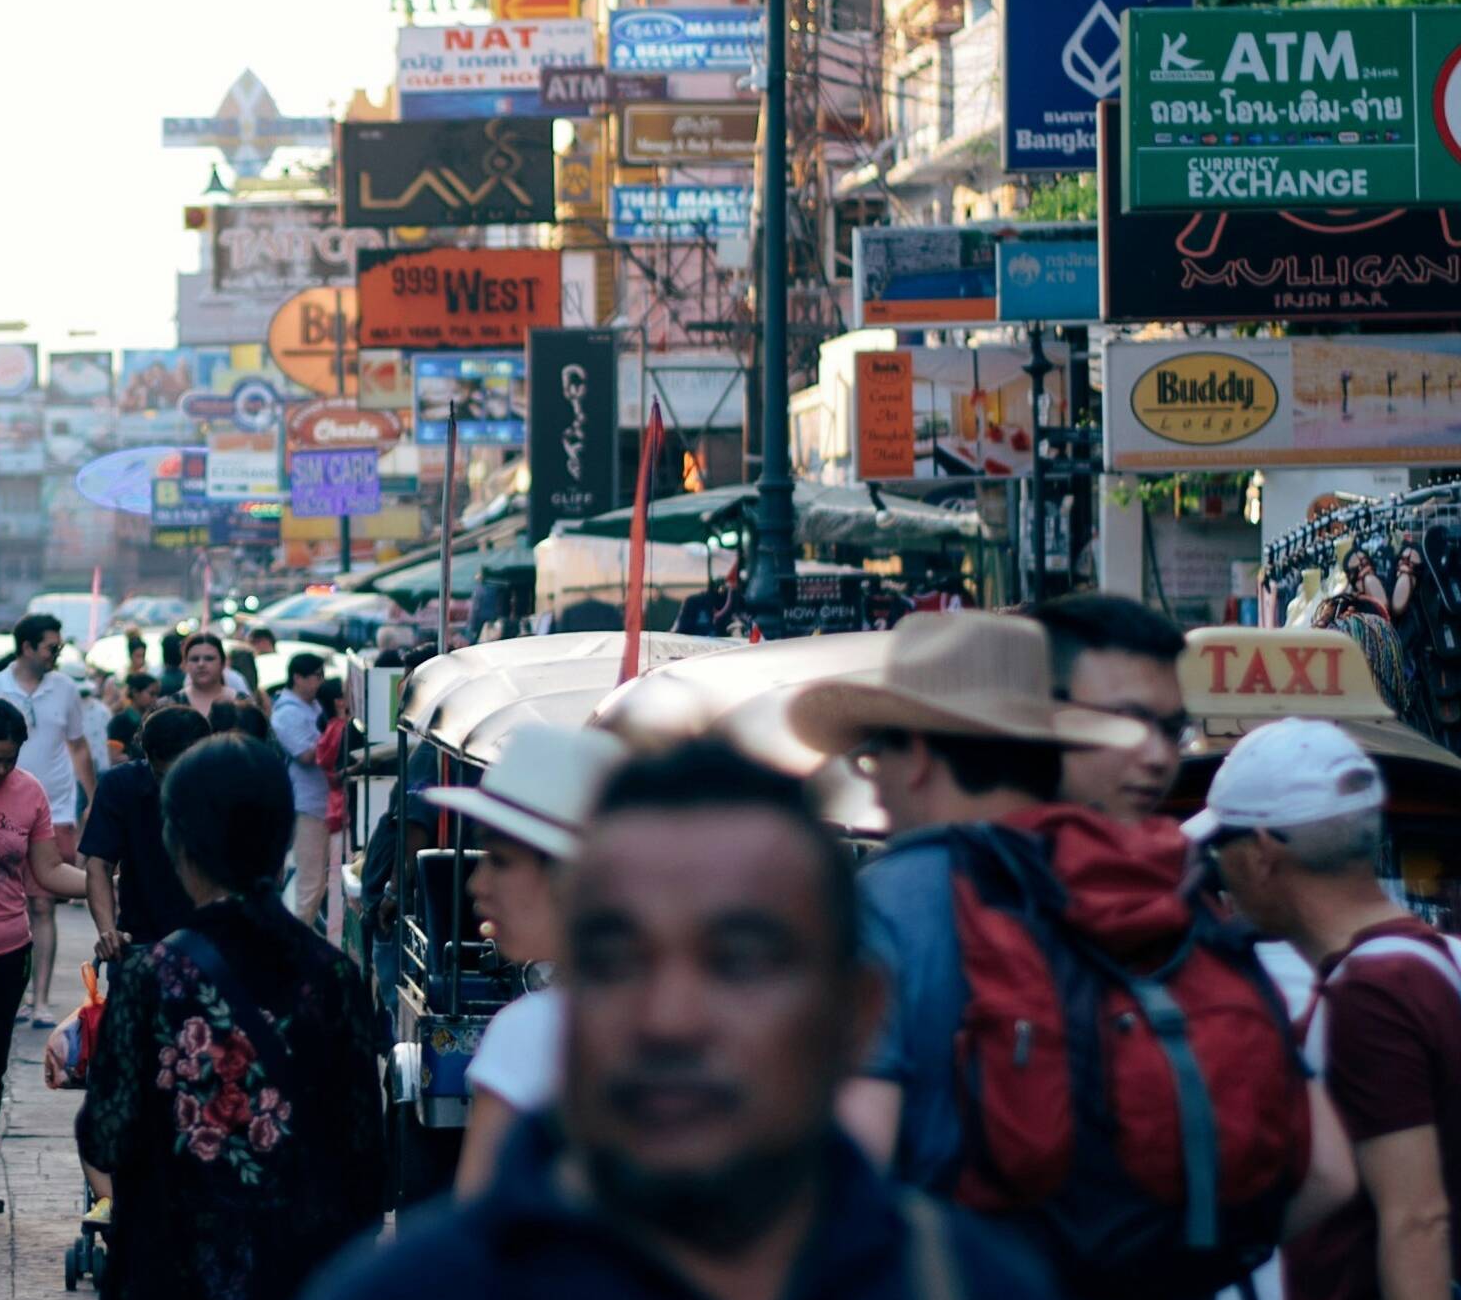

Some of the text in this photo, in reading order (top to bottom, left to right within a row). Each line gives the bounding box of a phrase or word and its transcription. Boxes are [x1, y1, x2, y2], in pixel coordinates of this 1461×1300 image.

[444, 26, 539, 51] NAT
[1221, 29, 1360, 84] ATM
[406, 73, 485, 87] GUEST
[545, 74, 608, 101] ATM
[1188, 156, 1280, 172] CURRENCY
[1188, 168, 1368, 199] EXCHANGE
[1045, 270, 1076, 284] KTB
[391, 266, 540, 316] 999 WEST
[1273, 292, 1388, 308] IRISH BAR
[1156, 370, 1254, 410] Buddy
[1158, 413, 1252, 435] Lodge
[293, 456, 325, 486] SIM
[1199, 644, 1346, 696] TAXI
